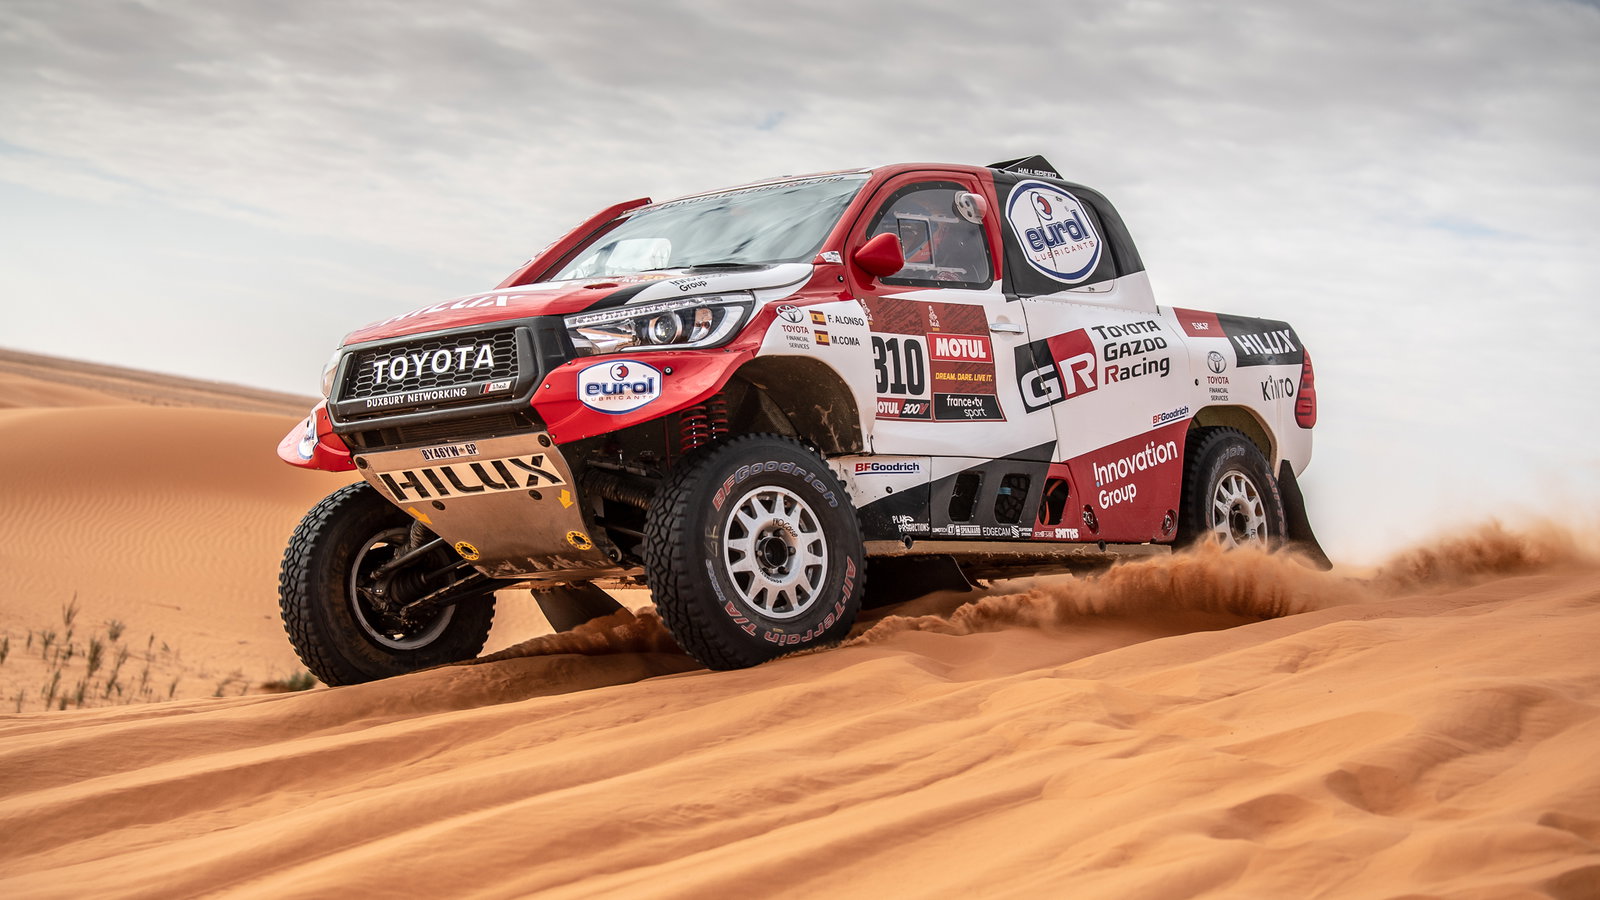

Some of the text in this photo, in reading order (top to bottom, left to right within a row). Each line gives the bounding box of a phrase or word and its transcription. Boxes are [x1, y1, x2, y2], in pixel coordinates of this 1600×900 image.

[1025, 209, 1090, 252] eurol
[1034, 240, 1095, 262] LUBRICANTS
[680, 280, 708, 292] Group
[781, 325, 810, 334] TOYOTA
[827, 315, 835, 323] F.
[835, 316, 865, 327] ALONSO
[1091, 319, 1162, 340] TOYOTA
[786, 335, 810, 343] FINANCIAL
[788, 342, 810, 350] SERVICES
[831, 335, 861, 347] M.COMA
[935, 337, 987, 359] MOTUL
[1104, 336, 1168, 362] GAZOO
[1233, 329, 1298, 356] HILUX
[373, 343, 495, 384] TOYOTA
[871, 336, 925, 396] 310
[1104, 356, 1171, 385] Racing
[585, 376, 655, 397] eurol
[935, 372, 957, 381] DREAM.
[957, 373, 974, 381] DARE.
[974, 374, 986, 382] LIVE
[1020, 352, 1097, 408] GR
[1207, 376, 1230, 385] TOYOTA
[366, 387, 468, 408] DUXBURY NETWORKING
[876, 401, 900, 414] OTUL
[964, 408, 987, 420] sport
[1152, 405, 1189, 424] BFGoodrich
[464, 443, 477, 455] GP
[855, 462, 920, 473] BFGoodrich
[1092, 440, 1178, 487] Innovation
[379, 455, 564, 502] HILUX
[712, 460, 839, 512] BFGoodrich
[1099, 483, 1137, 510] Group
[983, 527, 1012, 536] EDGECAM
[764, 555, 857, 647] All-Terrain
